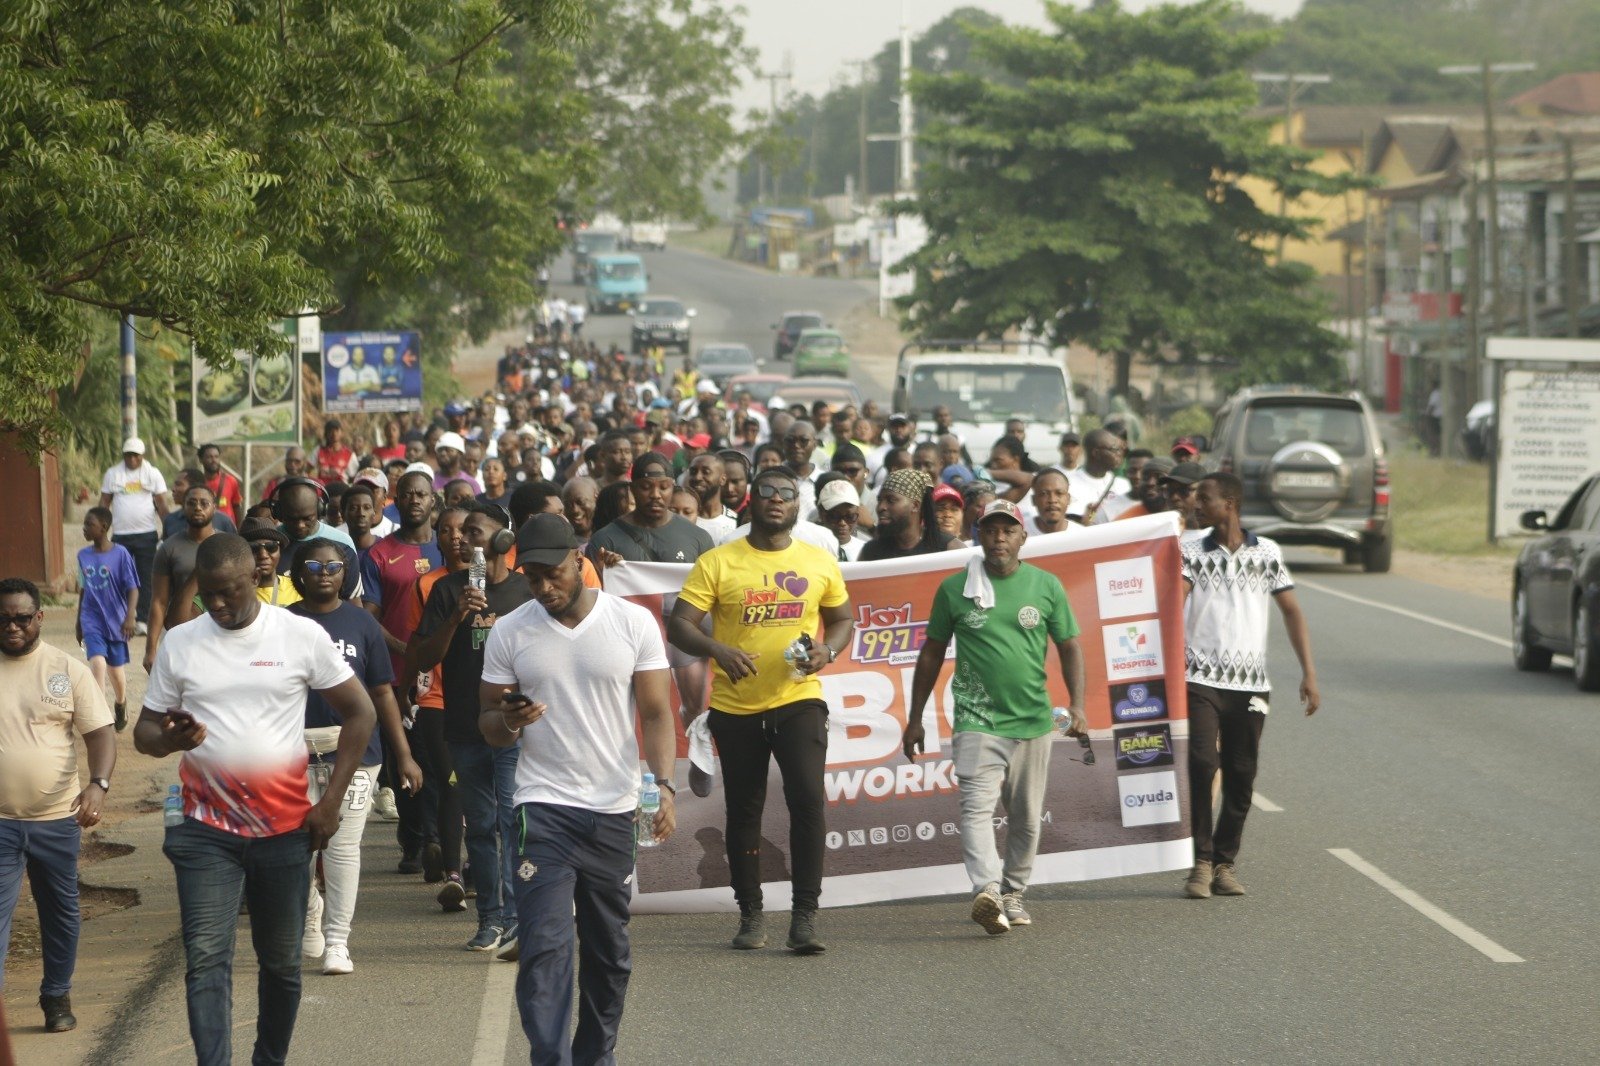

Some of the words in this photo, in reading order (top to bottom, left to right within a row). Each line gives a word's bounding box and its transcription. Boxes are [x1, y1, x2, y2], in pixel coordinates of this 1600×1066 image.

[763, 574, 768, 587] I
[778, 604, 802, 618] FM
[862, 628, 911, 660] 99.7
[1112, 659, 1158, 671] HOSPITAL
[40, 695, 70, 711] VERSACE
[1121, 704, 1159, 717] AFRIWARA
[820, 670, 955, 765] BI
[1120, 735, 1165, 752] GAME
[823, 760, 959, 802] WORK
